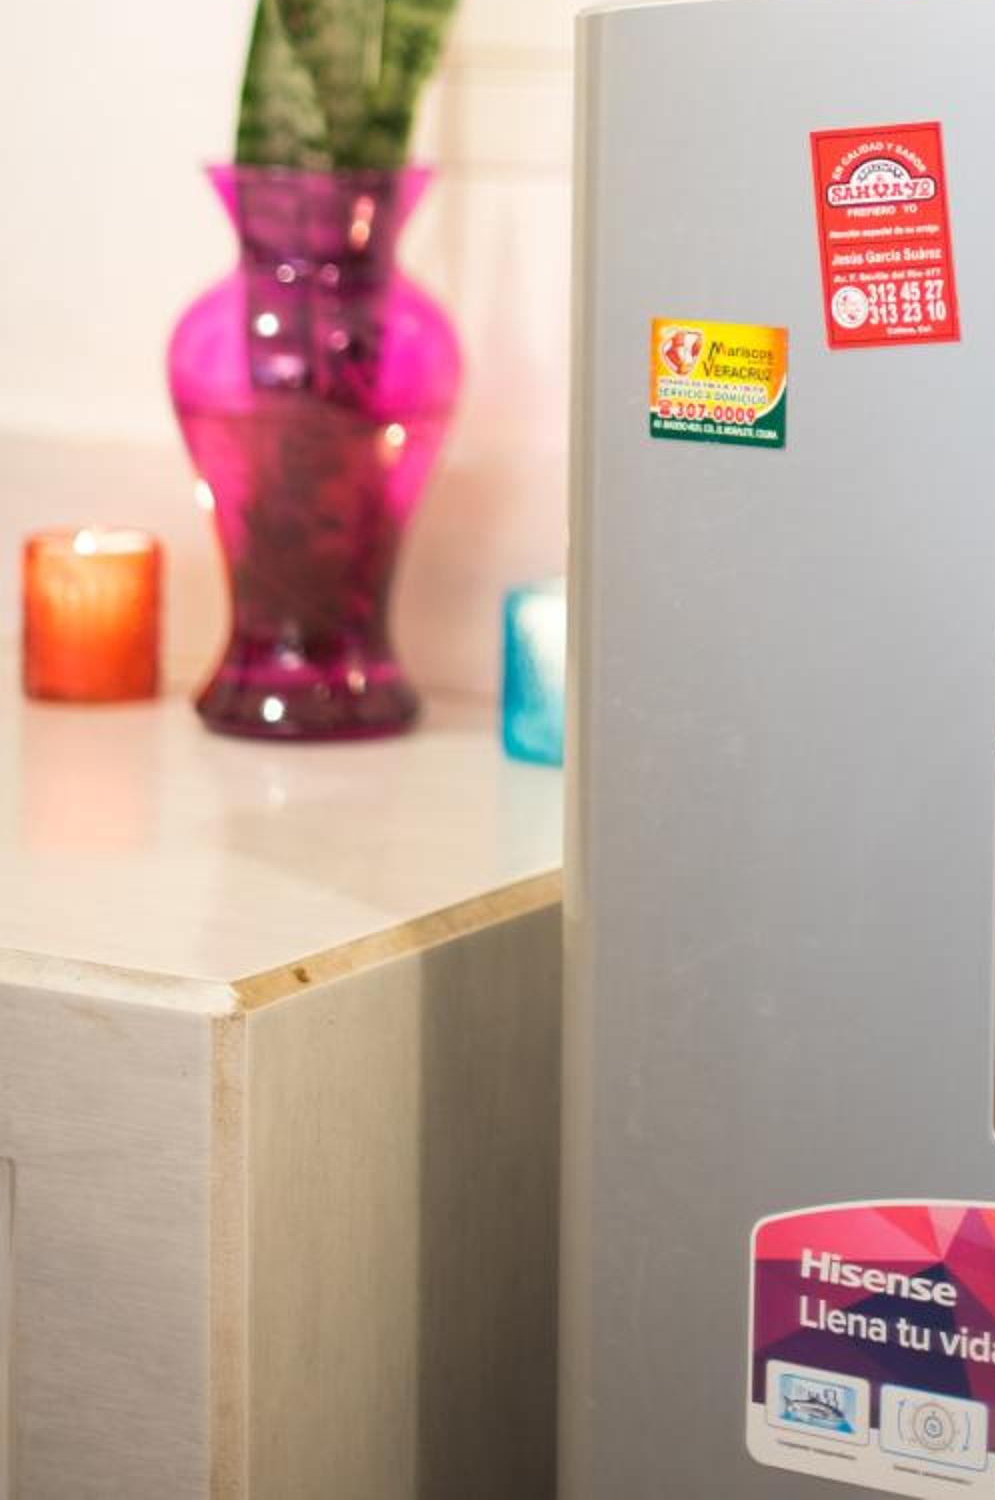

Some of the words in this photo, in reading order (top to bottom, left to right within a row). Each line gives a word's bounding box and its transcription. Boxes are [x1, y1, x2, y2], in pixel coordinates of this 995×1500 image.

[867, 282, 896, 304] 312
[900, 280, 920, 302] 45
[924, 279, 944, 300] 27
[869, 303, 898, 325] 313
[902, 301, 922, 323] 23
[927, 300, 946, 321] 10
[800, 1247, 958, 1307] Hisense
[800, 1295, 887, 1344] Llena
[896, 1316, 931, 1351] tu
